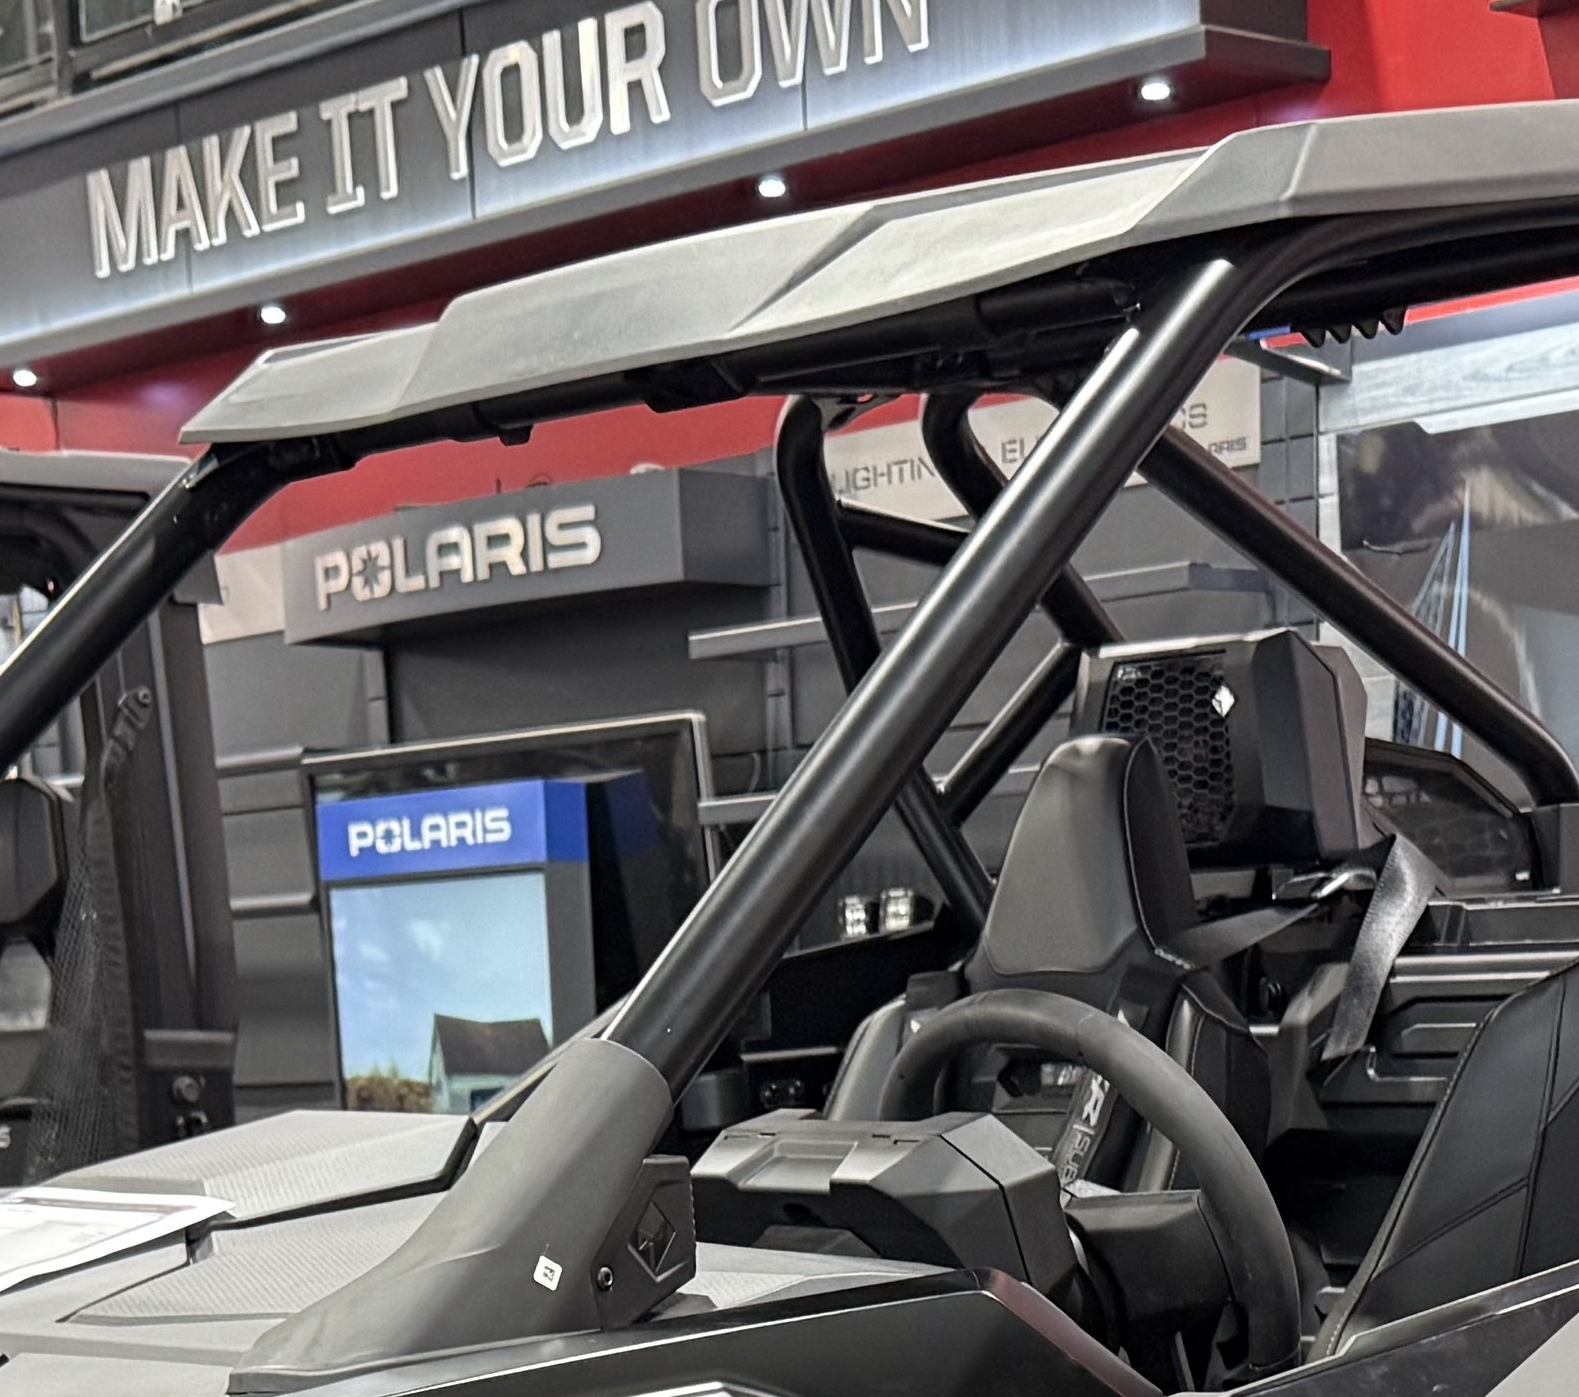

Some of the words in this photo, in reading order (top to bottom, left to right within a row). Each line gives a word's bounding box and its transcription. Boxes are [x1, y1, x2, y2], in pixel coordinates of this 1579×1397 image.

[86, 110, 306, 279] MAKE
[320, 76, 409, 214] IT
[423, 0, 671, 180] YOUR
[694, 0, 929, 107] OWN
[315, 503, 602, 612] POLARIS
[347, 806, 513, 858] POLARIS
